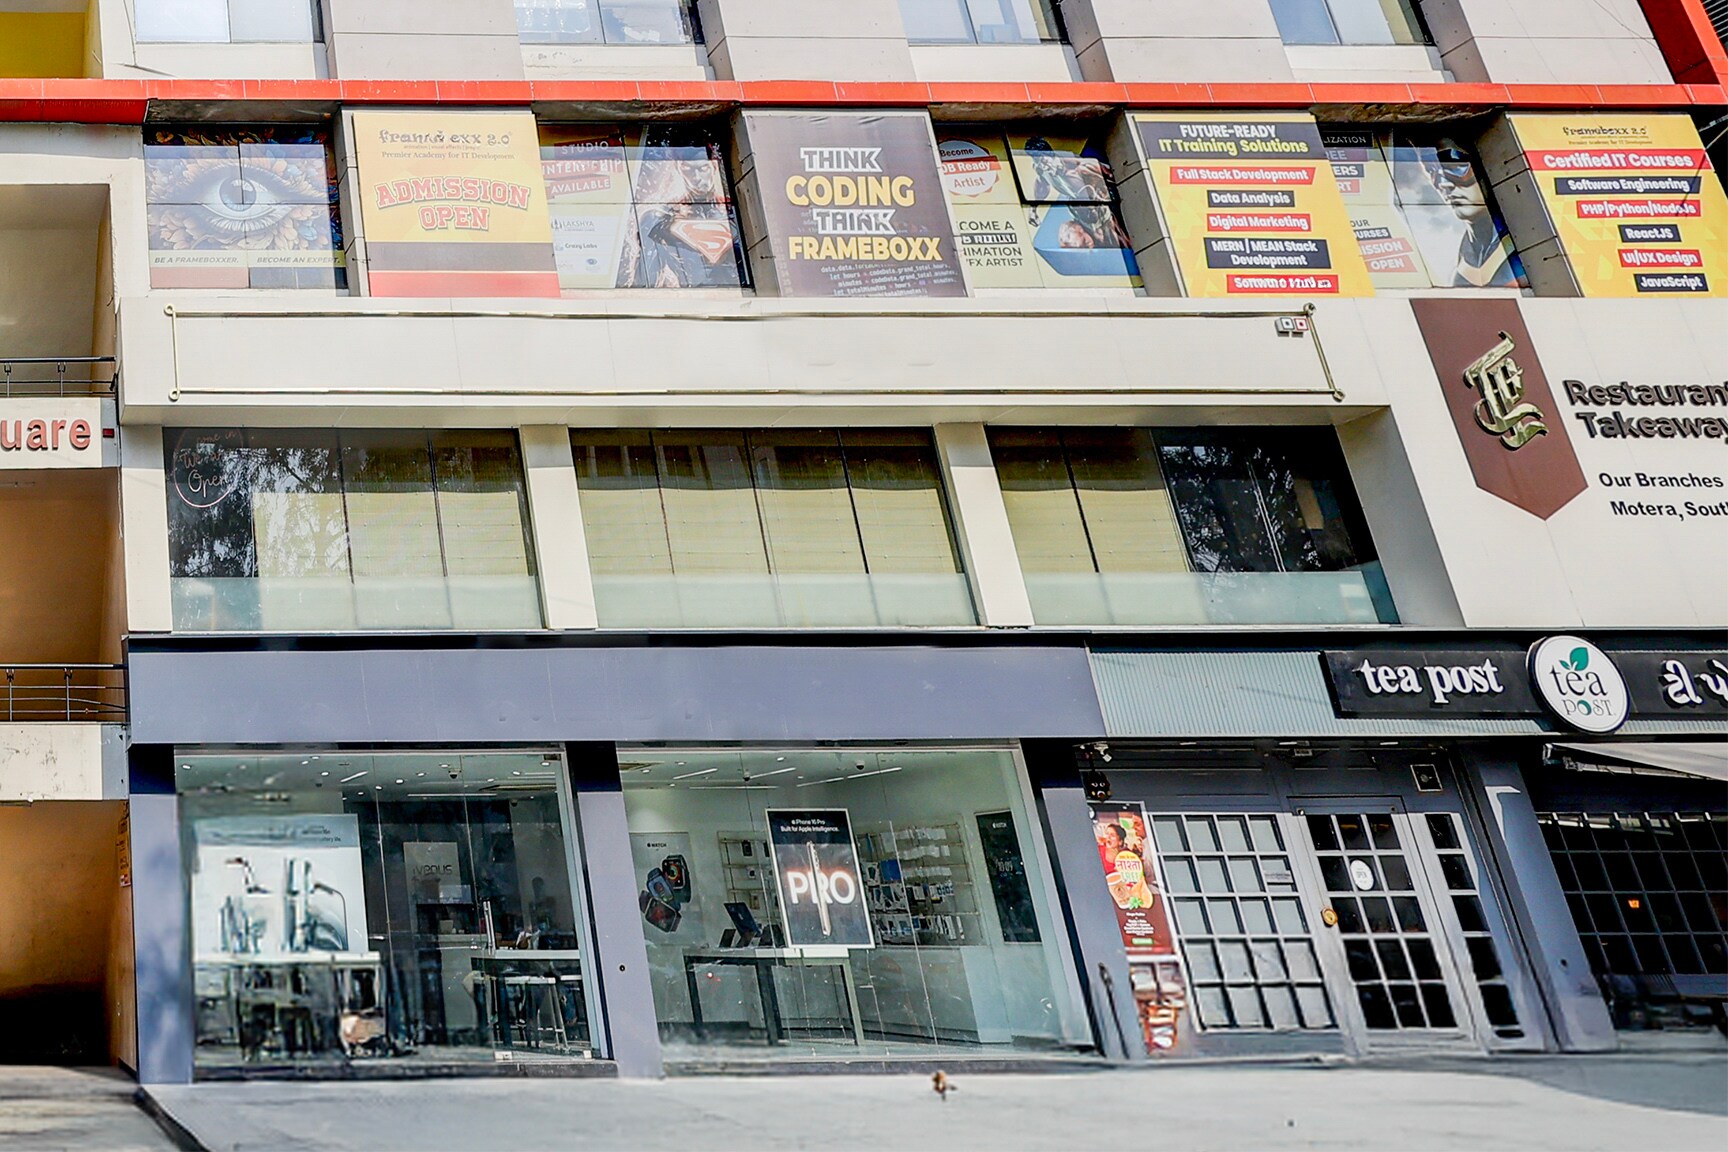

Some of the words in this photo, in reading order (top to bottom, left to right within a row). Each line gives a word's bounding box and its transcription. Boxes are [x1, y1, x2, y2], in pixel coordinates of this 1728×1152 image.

[1180, 125, 1276, 138] FUTURE-READY
[562, 141, 609, 155] STUDIO
[940, 149, 974, 157] Become
[1159, 139, 1173, 152] IT
[1174, 139, 1237, 156] Training
[1241, 139, 1309, 153] Solutions
[414, 152, 446, 160] Academy
[802, 149, 880, 170] THINK
[1543, 154, 1613, 168] Certified
[1614, 154, 1625, 166] IT
[1628, 153, 1694, 167] Courses
[958, 161, 990, 171] Ready
[954, 177, 985, 188] Artist
[1177, 169, 1200, 179] Full
[1201, 169, 1232, 179] Stack
[1232, 169, 1309, 182] Development
[375, 176, 531, 210] ADMISSION
[551, 179, 610, 194] AVAILABLE
[786, 176, 915, 207] CODING
[1568, 179, 1620, 191] Software
[1620, 179, 1690, 193] Engineering
[1211, 193, 1240, 203] Data
[1242, 192, 1290, 206] Analysis
[419, 205, 490, 231] OPEN
[1209, 216, 1249, 230] Digital
[1249, 216, 1309, 230] Marketing
[1005, 221, 1014, 230] A
[1625, 228, 1673, 239] ReactJS
[788, 236, 943, 260] FRAMEBOXX
[1211, 240, 1244, 252] MERN
[1251, 241, 1285, 252] MEAN
[1286, 241, 1318, 252] Stack
[986, 258, 1023, 266] ARTIST
[1231, 255, 1307, 268] Development
[1370, 258, 1404, 270] OPEN
[1622, 250, 1656, 266] UI/UX
[1656, 251, 1698, 266] Design
[1641, 275, 1703, 290] JavaScript
[188, 469, 230, 497] Open
[1599, 473, 1631, 487] Our
[1634, 472, 1724, 488] Branches
[1610, 501, 1685, 521] Motera,
[1354, 658, 1422, 694] tea
[1424, 658, 1504, 704] post
[1550, 663, 1608, 697] tea
[787, 871, 855, 904] PRO
